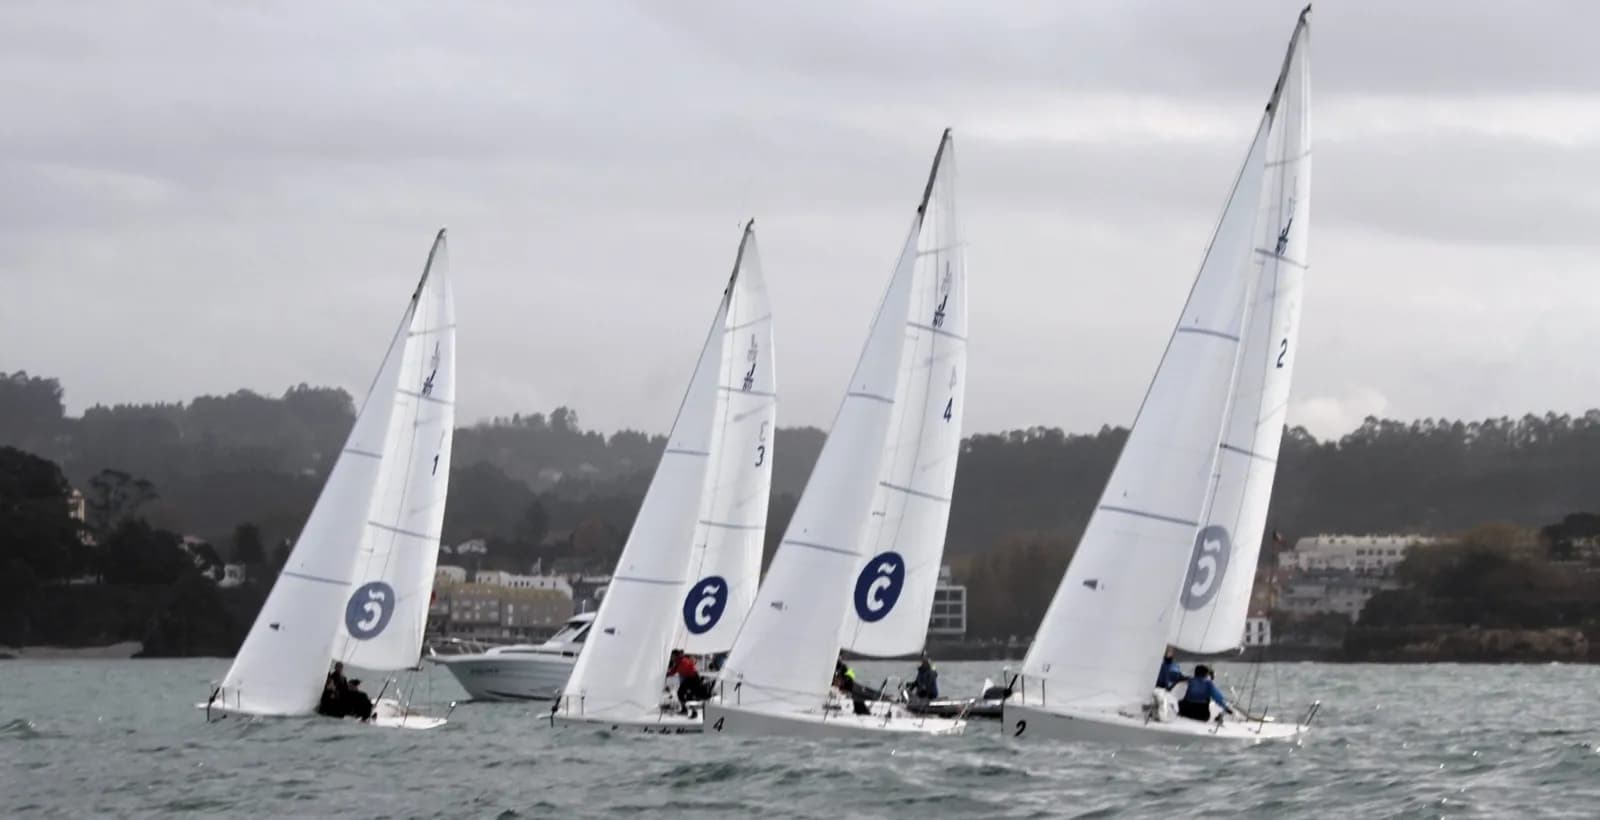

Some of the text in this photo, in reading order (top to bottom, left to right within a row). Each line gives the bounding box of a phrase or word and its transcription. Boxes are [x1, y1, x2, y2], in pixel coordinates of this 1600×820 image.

[1276, 337, 1289, 369] 2
[943, 397, 953, 423] 4
[431, 453, 440, 476] 1
[754, 445, 766, 468] 3
[712, 716, 726, 733] 4
[1013, 719, 1028, 737] 2
